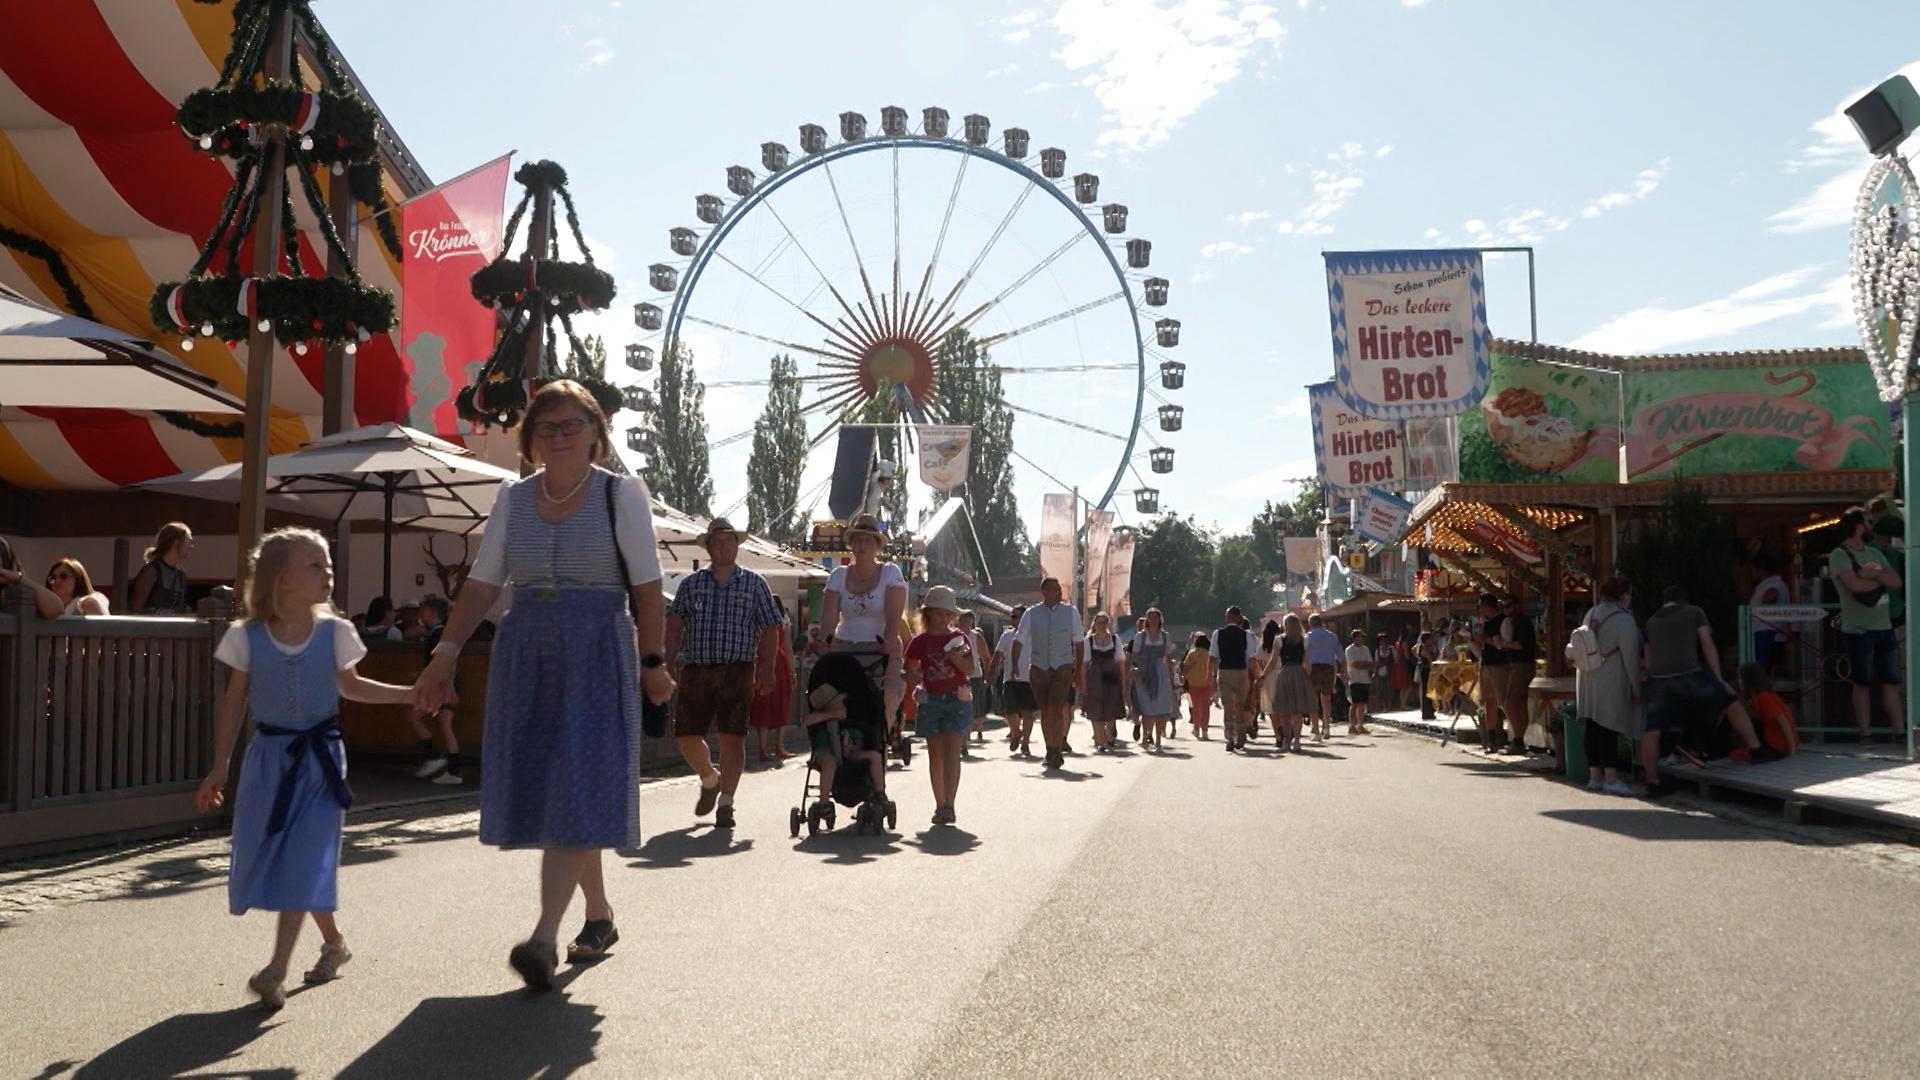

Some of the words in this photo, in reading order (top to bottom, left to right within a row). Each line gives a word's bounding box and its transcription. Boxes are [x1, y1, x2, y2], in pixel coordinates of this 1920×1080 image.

[1393, 282, 1424, 295] Schon
[1427, 266, 1467, 288] probiert?
[1365, 299, 1399, 316] Das
[1405, 298, 1452, 315] leckere
[1358, 325, 1463, 360] Hirten-
[1382, 365, 1448, 402] Brot
[1336, 413, 1358, 426] Das
[1348, 455, 1394, 484] Brot
